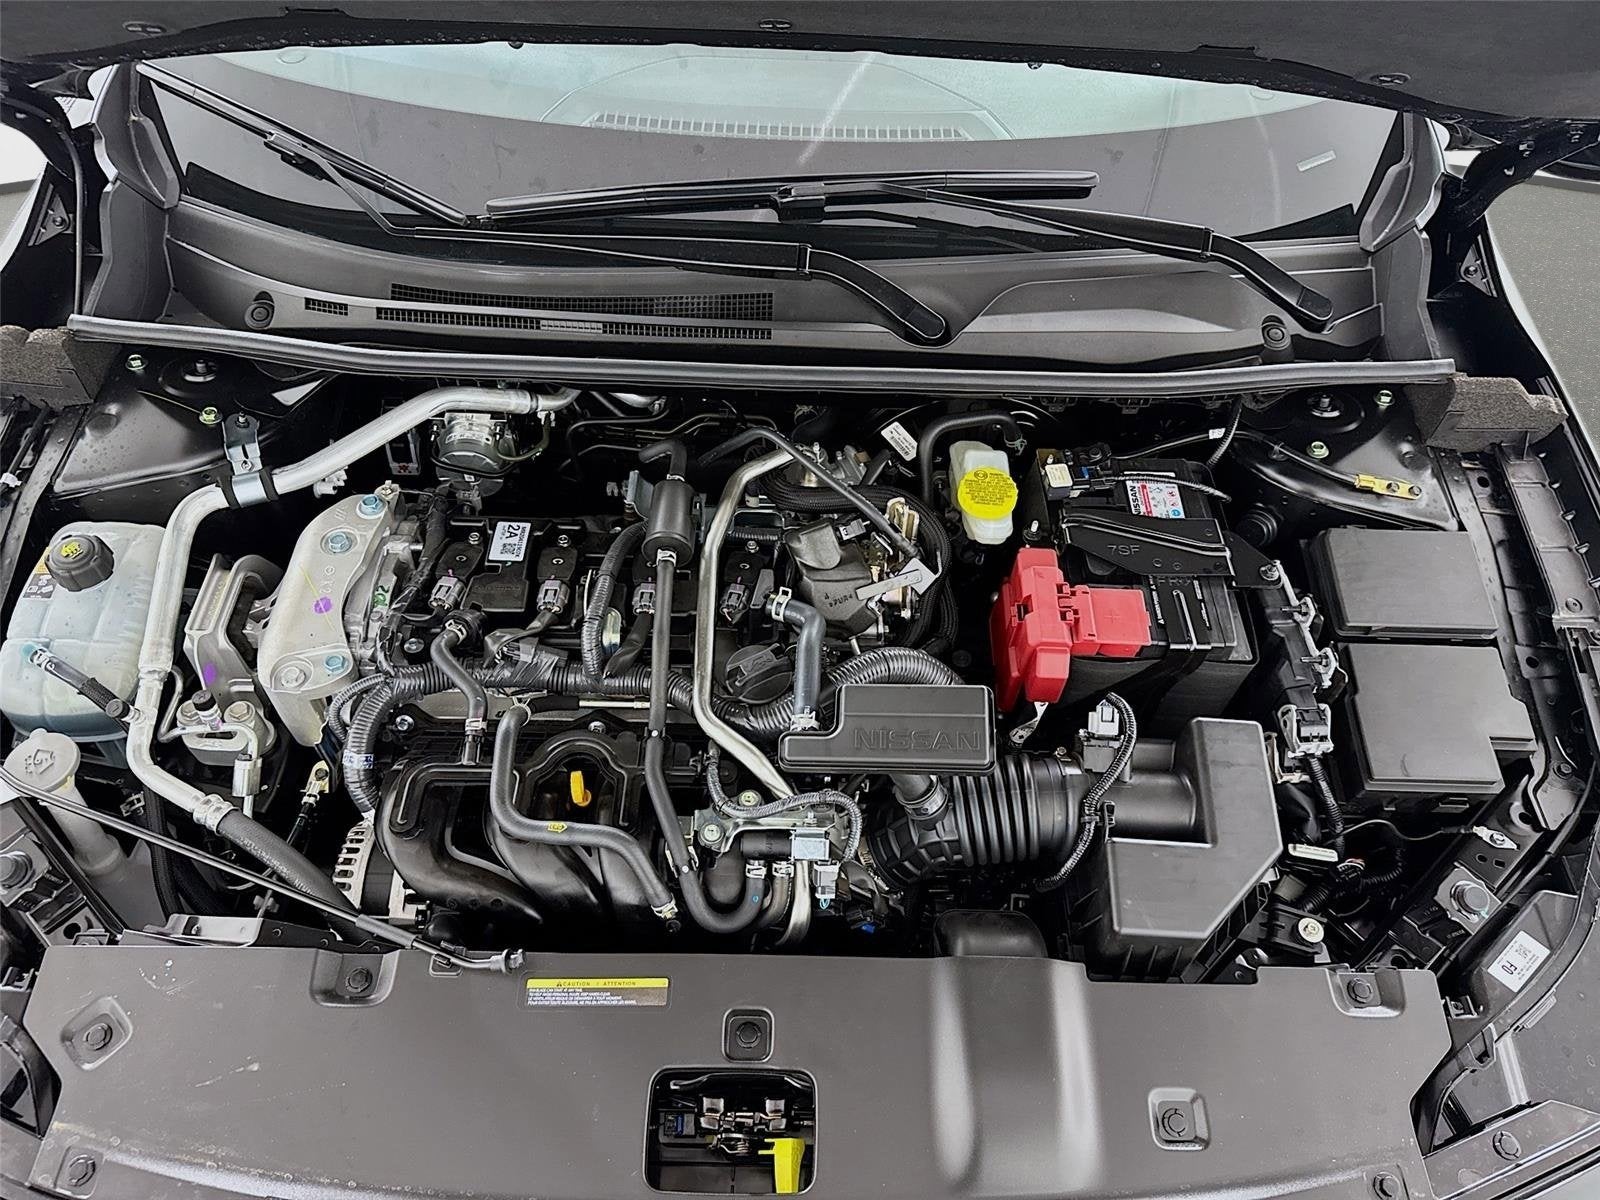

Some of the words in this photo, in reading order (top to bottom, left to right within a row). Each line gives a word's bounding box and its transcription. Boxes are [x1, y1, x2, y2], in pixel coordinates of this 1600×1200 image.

[1129, 485, 1141, 514] NISSAN
[505, 524, 521, 539] 2A
[1107, 544, 1140, 555] 7SF
[854, 728, 981, 752] NISSAN
